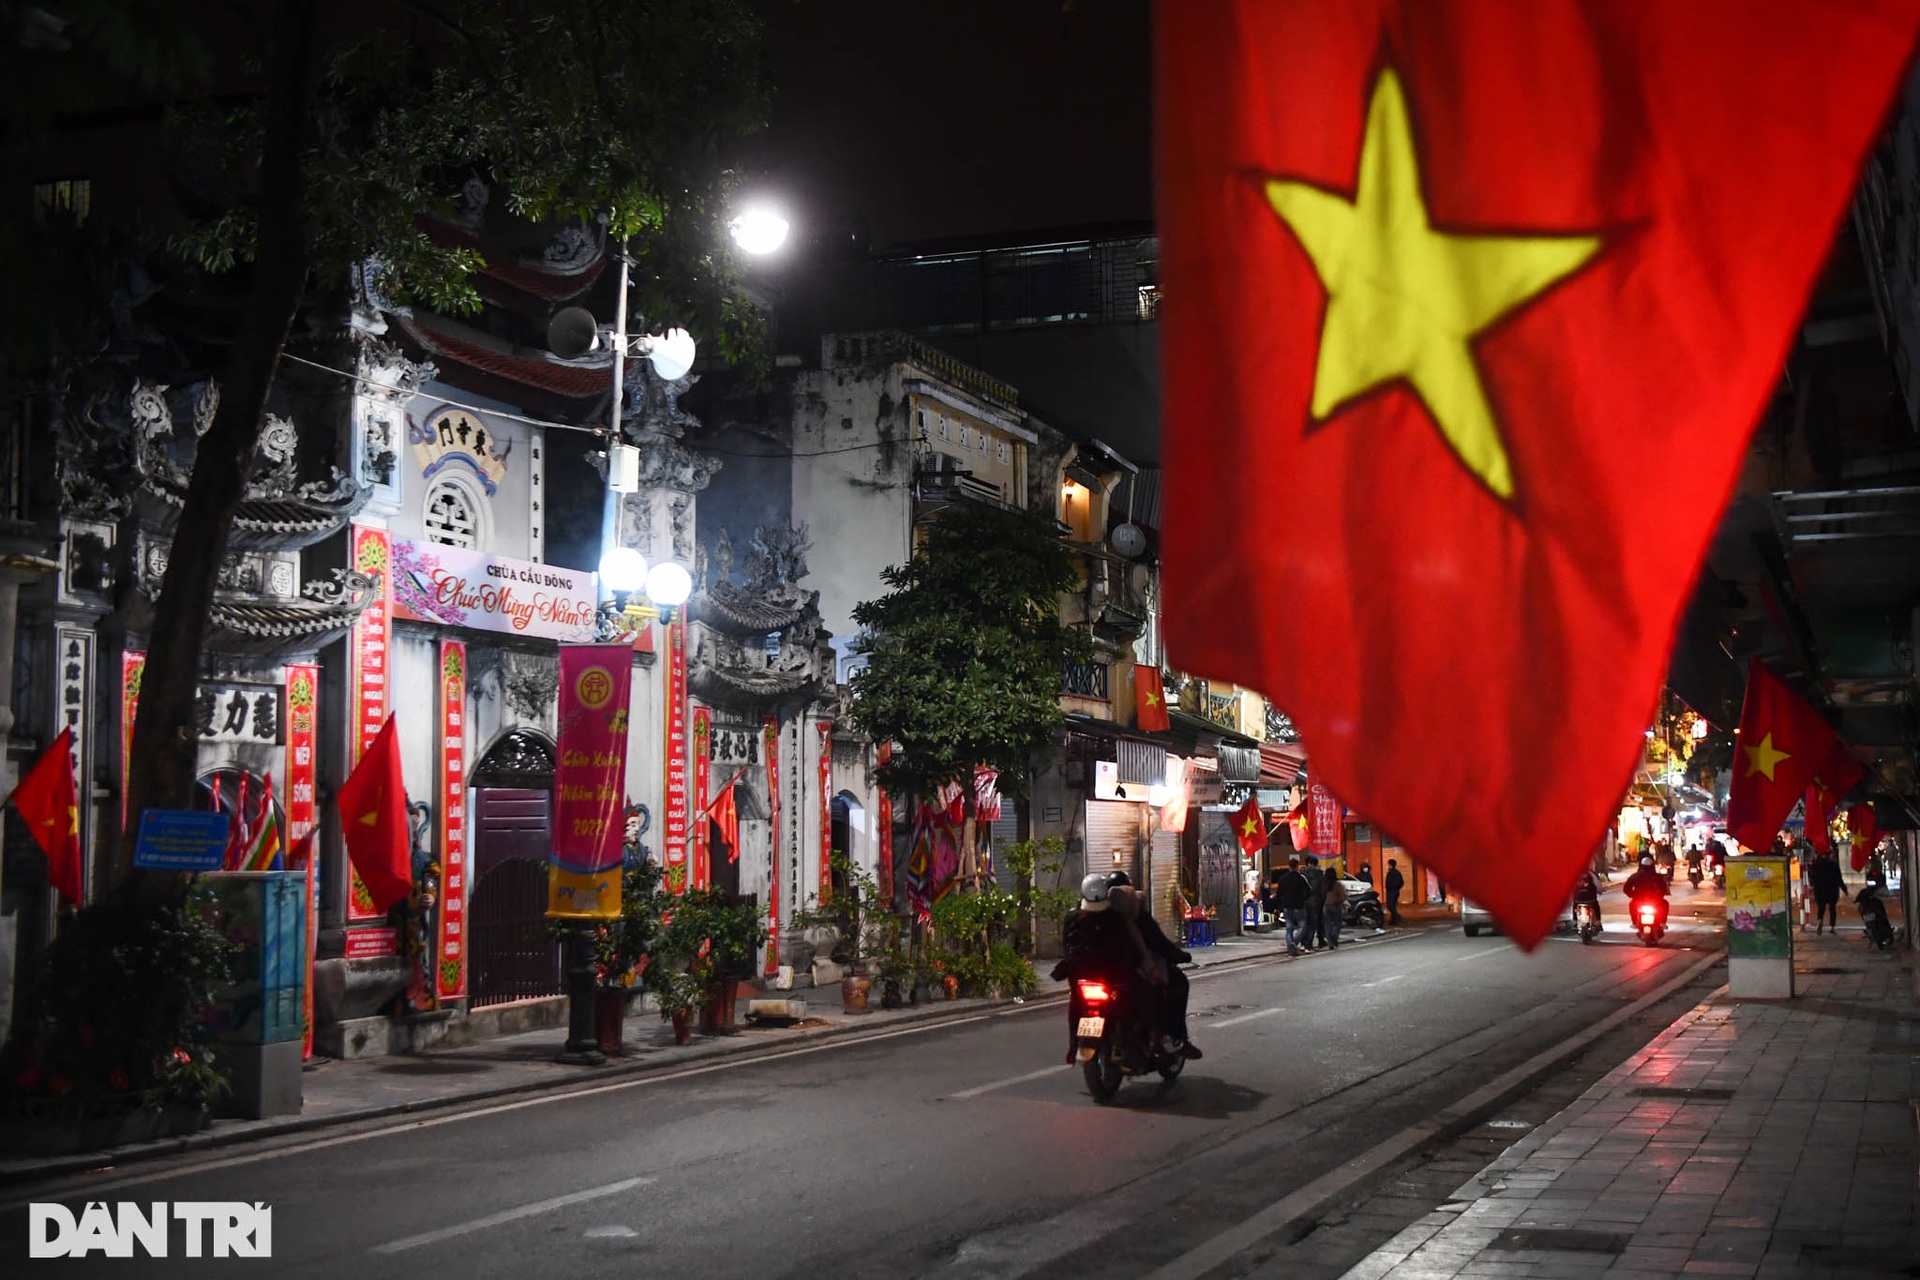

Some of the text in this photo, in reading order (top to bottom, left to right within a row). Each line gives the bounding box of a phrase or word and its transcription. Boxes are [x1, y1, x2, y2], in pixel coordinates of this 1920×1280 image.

[433, 568, 481, 609] Chúc
[534, 592, 579, 626] Năm
[544, 574, 573, 590] ĐÔNG
